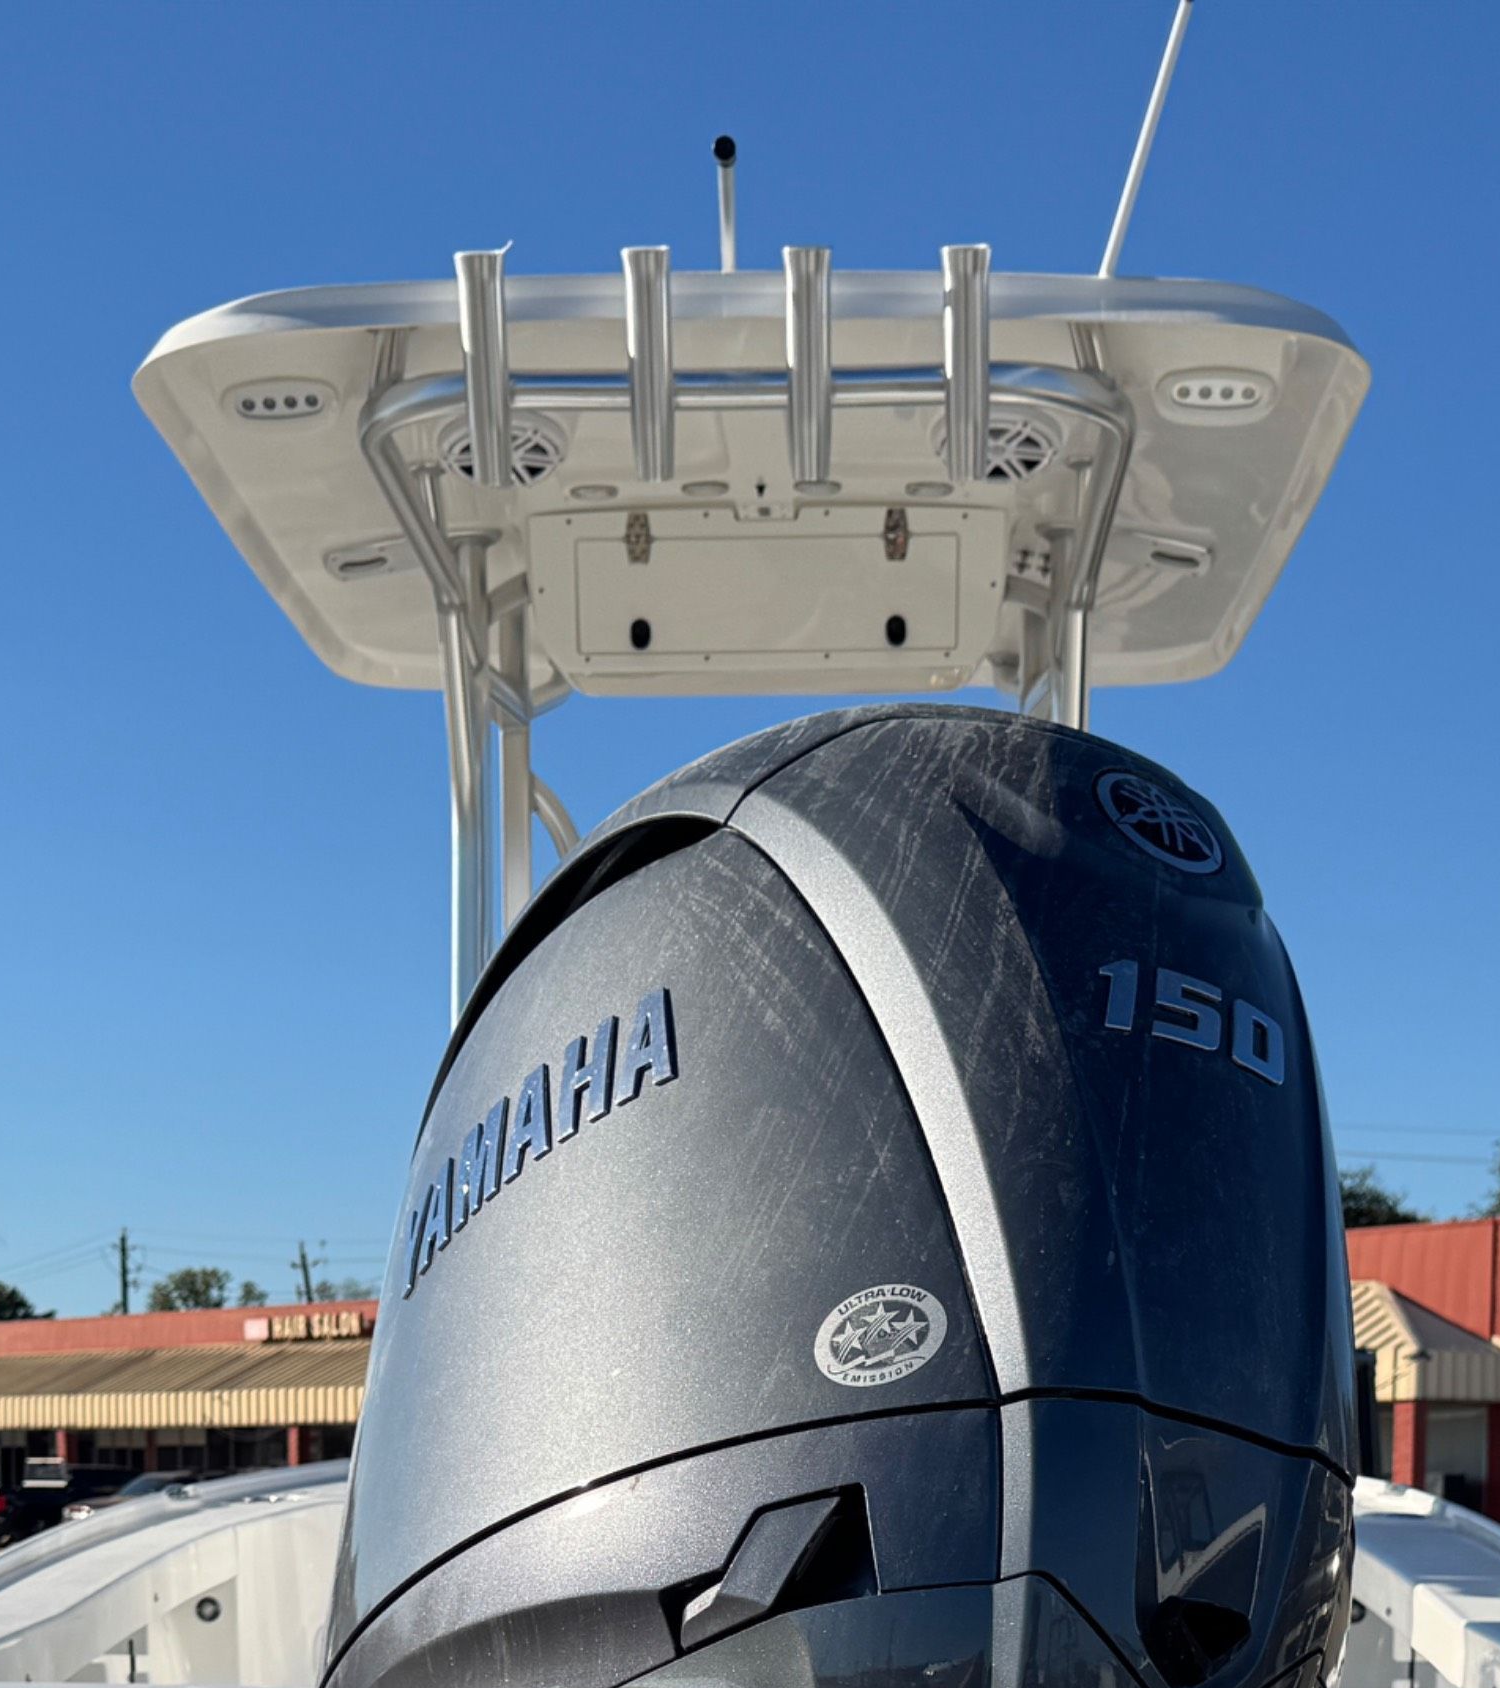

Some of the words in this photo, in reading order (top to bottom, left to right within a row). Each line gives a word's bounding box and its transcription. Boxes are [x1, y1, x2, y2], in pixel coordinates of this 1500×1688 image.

[1098, 958, 1286, 1087] 150
[402, 986, 680, 1301] YAMAHA
[272, 1313, 307, 1340] HAIR
[310, 1310, 362, 1338] SALON
[842, 1361, 914, 1383] EMISSION
